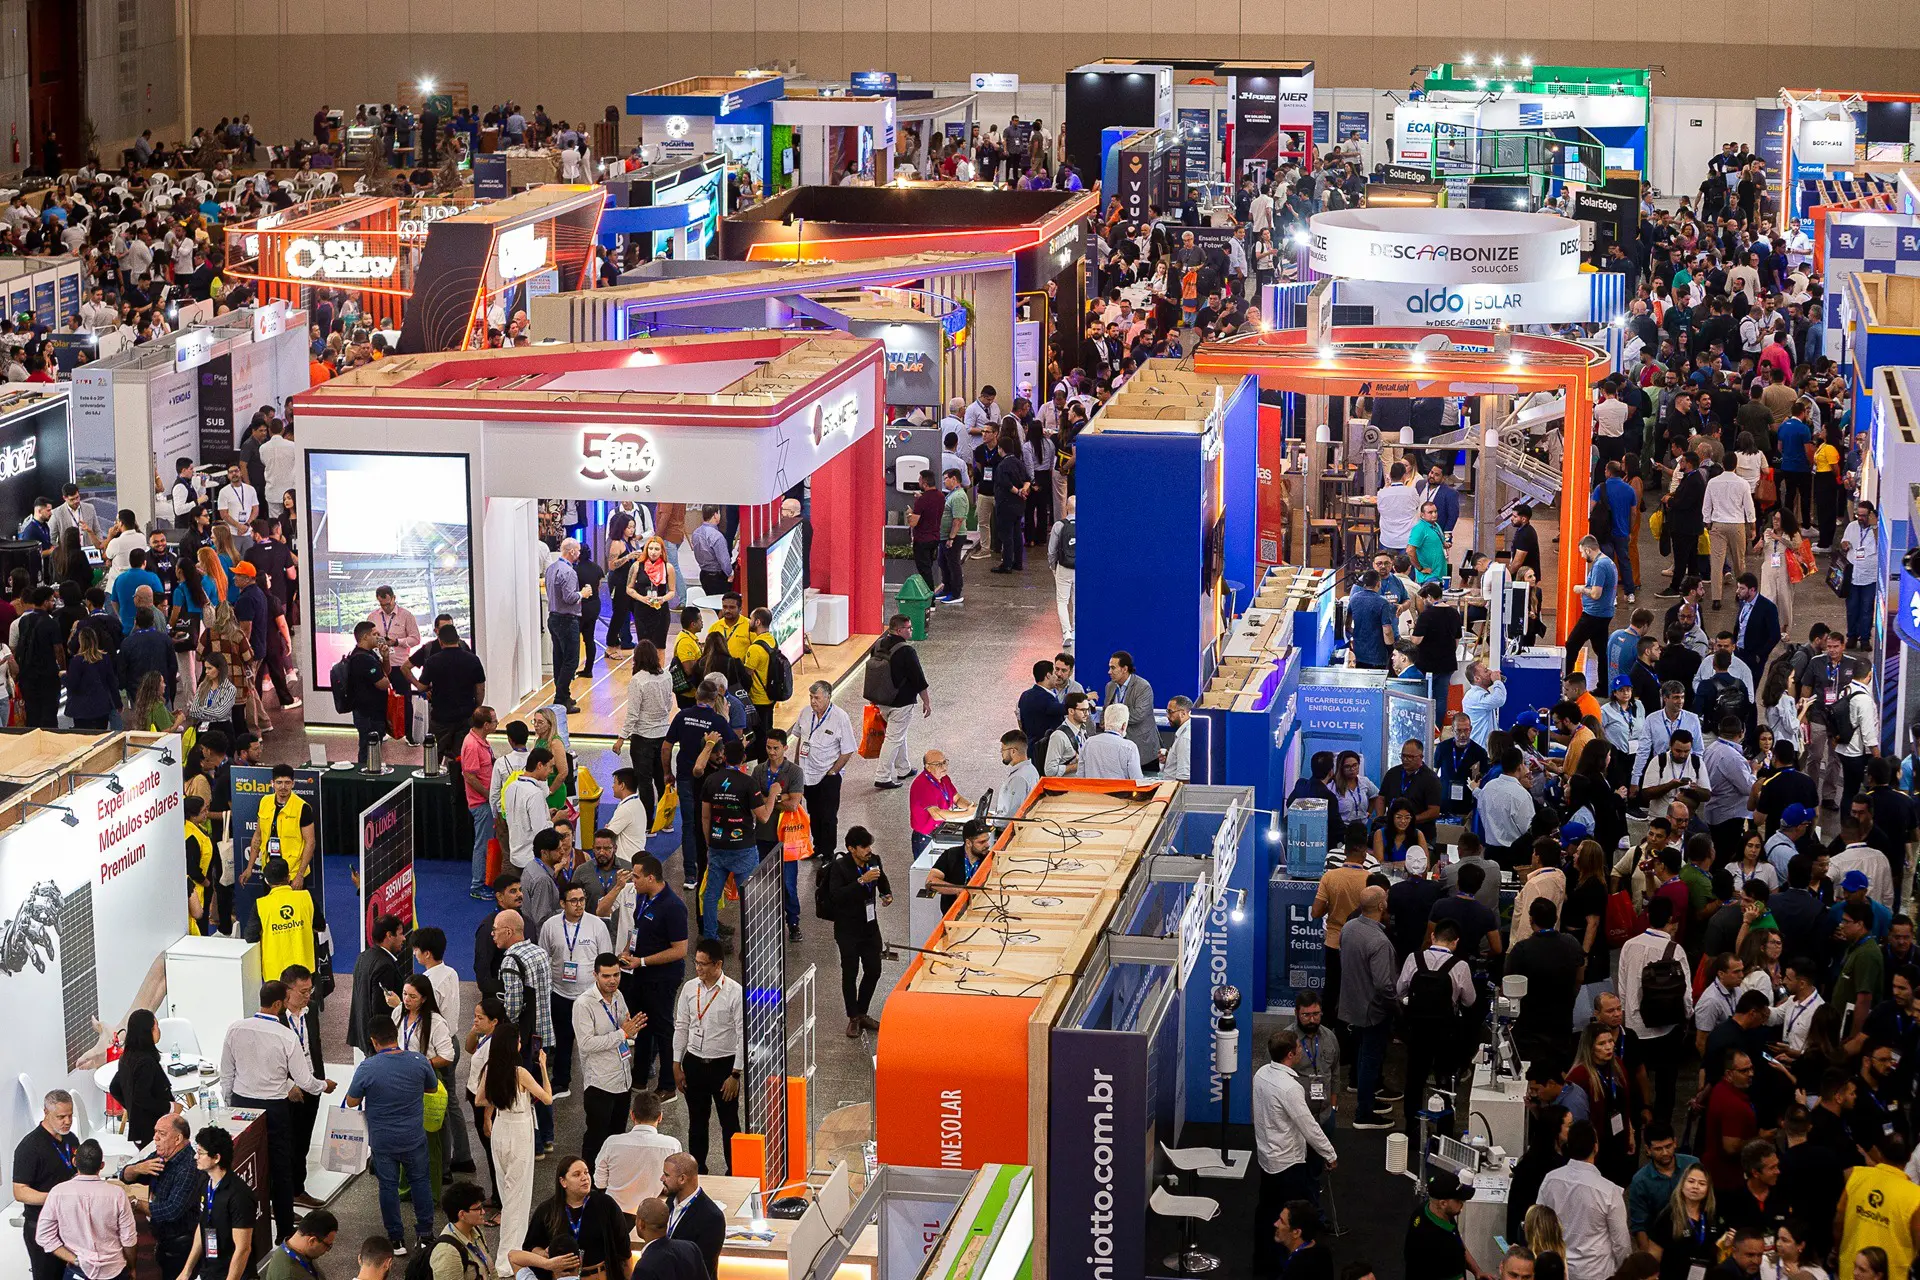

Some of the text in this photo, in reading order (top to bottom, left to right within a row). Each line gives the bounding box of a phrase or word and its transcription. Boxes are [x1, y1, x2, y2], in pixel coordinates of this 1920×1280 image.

[1544, 110, 1576, 120] EBARA
[1389, 169, 1426, 183] SolarEdge
[1580, 196, 1618, 213] SolarEdge
[1370, 243, 1520, 262] DESCARBONIZE
[322, 255, 398, 279] energy
[1471, 263, 1519, 275] SOLUÇÕES
[1407, 286, 1523, 314] aldo SOLAR
[1434, 317, 1502, 328] DESCARBONIZE
[888, 363, 923, 373] SOLAR
[1375, 382, 1410, 392] MetalLight
[172, 390, 191, 405] VENDAS
[206, 417, 226, 426] SUB
[611, 484, 652, 492] ANOS
[1304, 696, 1354, 705] RECARREGUE
[1308, 704, 1341, 712] ENERGIA
[1342, 705, 1359, 713] COM
[1309, 720, 1365, 730] LIVOLTEK
[235, 779, 273, 793] solar
[97, 771, 161, 820] Experimente
[144, 791, 179, 825] solares
[98, 813, 143, 853] Módulos
[1287, 839, 1325, 847] LIVOLTEK
[100, 843, 146, 885] Premium
[385, 875, 403, 902] 585W
[271, 919, 305, 932] Resolve
[1290, 939, 1323, 951] feitas
[331, 1131, 348, 1140] invt
